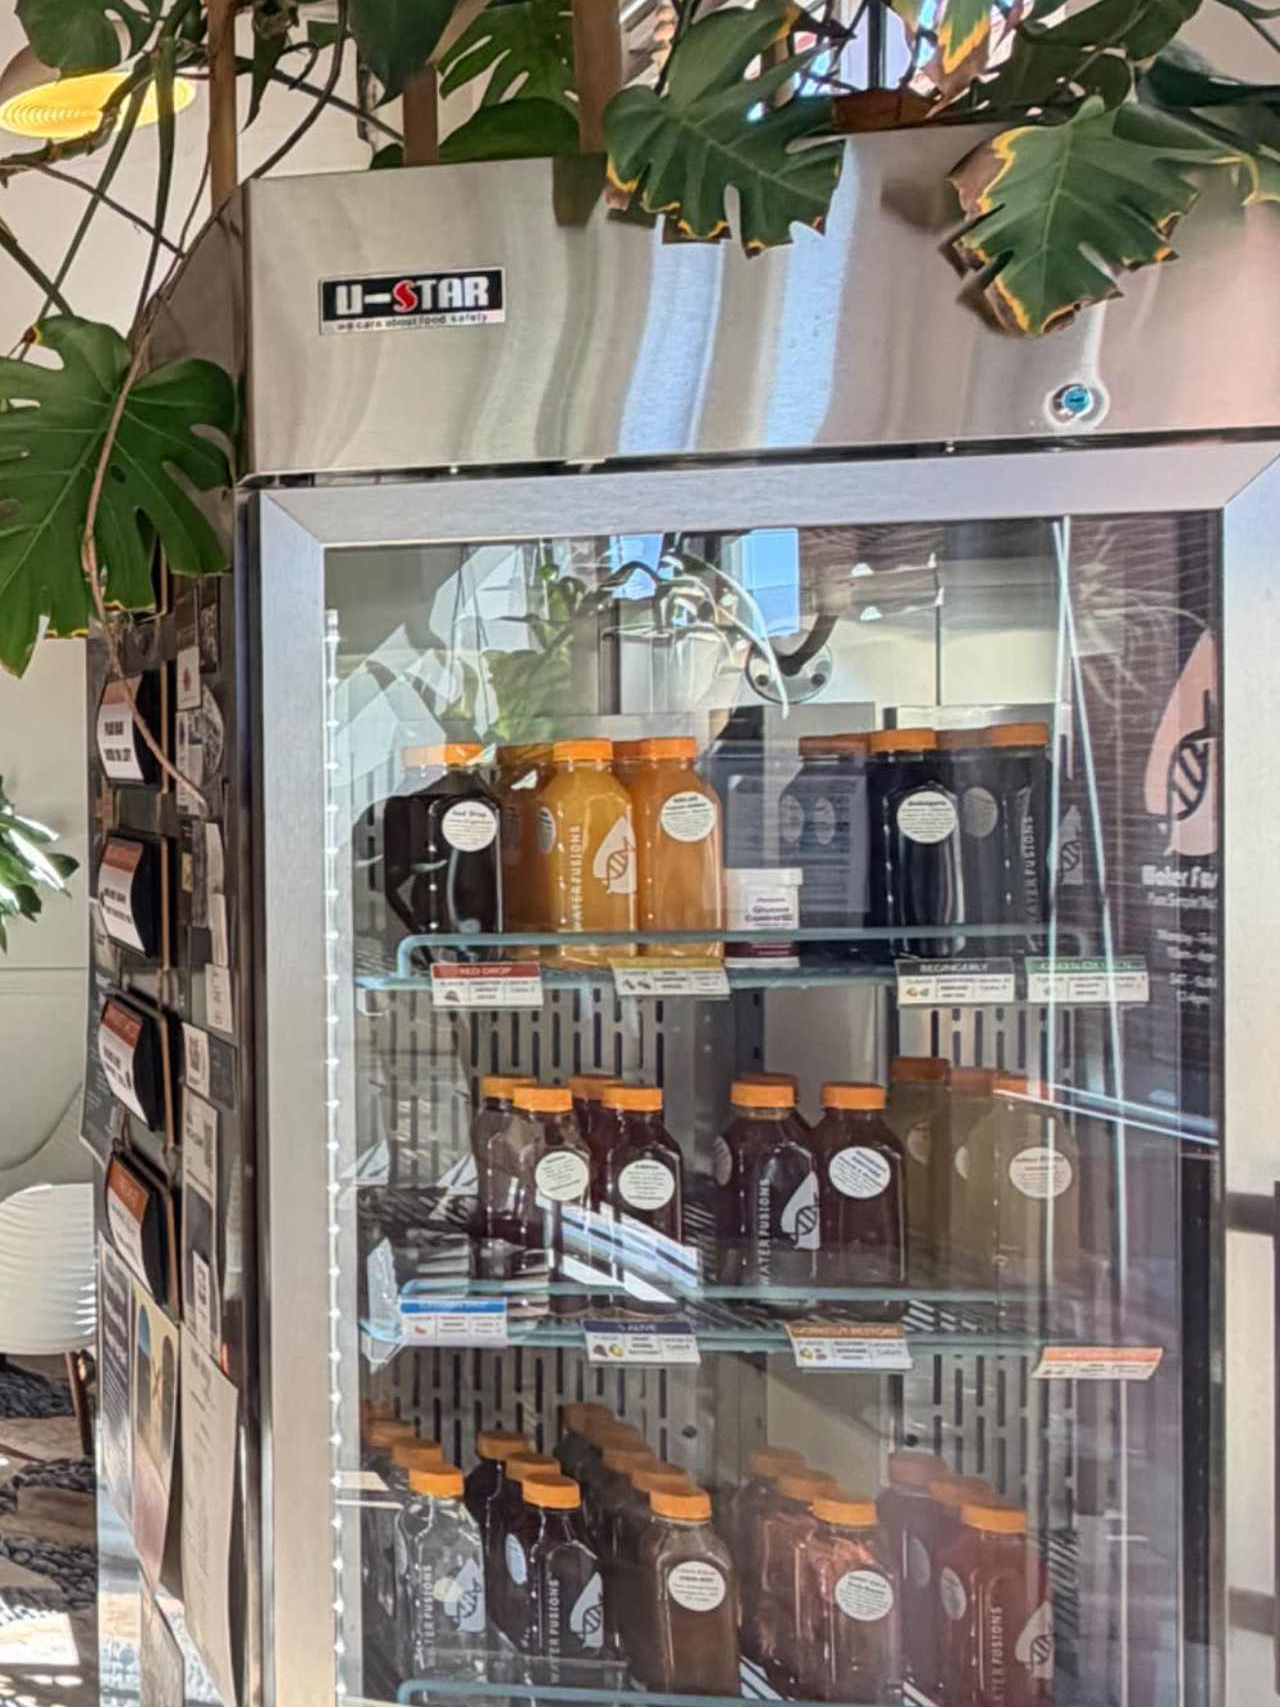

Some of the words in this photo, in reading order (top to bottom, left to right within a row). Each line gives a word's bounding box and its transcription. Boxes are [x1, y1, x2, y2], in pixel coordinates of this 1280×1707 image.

[336, 276, 489, 315] U-STAR
[570, 825, 583, 884] FUSIONS
[757, 1178, 770, 1237] FUSIONS
[548, 1579, 561, 1636] FUSIONS
[991, 1606, 1004, 1665] FUSIONS
